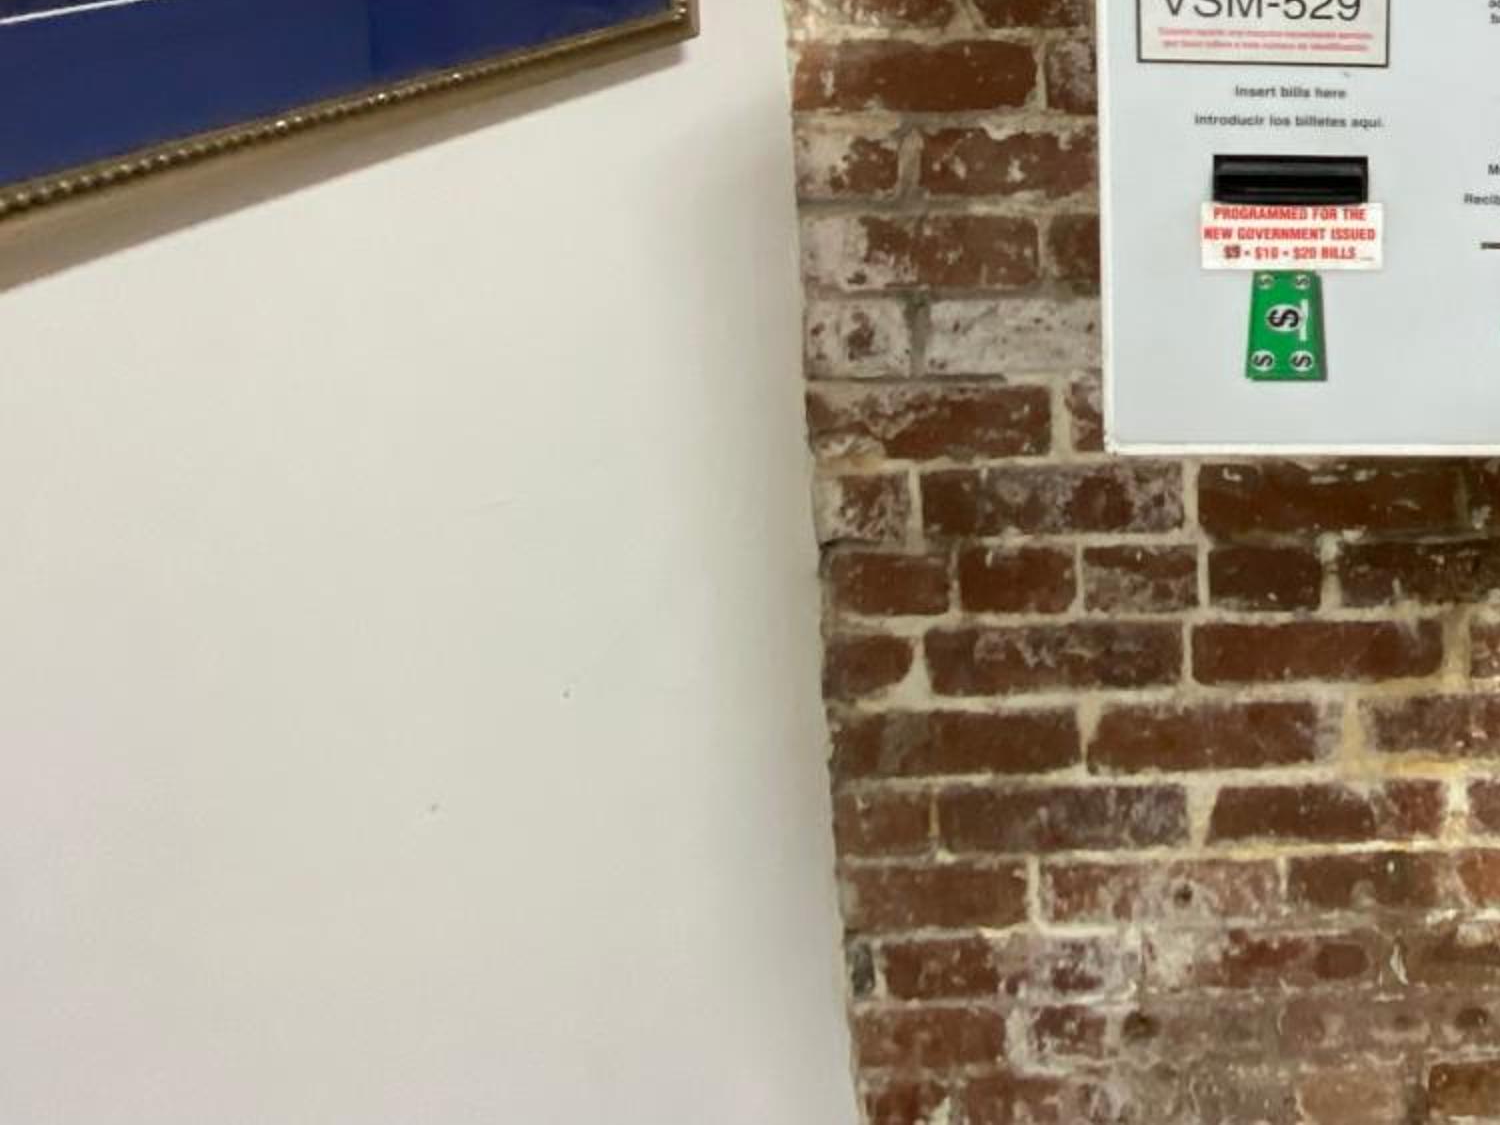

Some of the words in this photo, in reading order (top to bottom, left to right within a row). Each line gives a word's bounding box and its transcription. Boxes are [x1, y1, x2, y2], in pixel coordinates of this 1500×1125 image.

[1235, 85, 1276, 98] Insert
[1280, 86, 1311, 98] bills
[1315, 87, 1346, 99] here
[1195, 114, 1264, 126] Introducir
[1270, 115, 1290, 127] los
[1295, 116, 1348, 128] billetes
[1213, 207, 1308, 220] PROGRAMMED
[1312, 208, 1337, 220] FOR
[1343, 208, 1367, 220] THE
[1204, 228, 1232, 240] NEW
[1237, 228, 1326, 241] GOVERNMENT
[1331, 229, 1376, 241] ISSUED
[1255, 247, 1279, 259] $10
[1294, 247, 1317, 259] $20
[1321, 247, 1356, 259] BILLS
